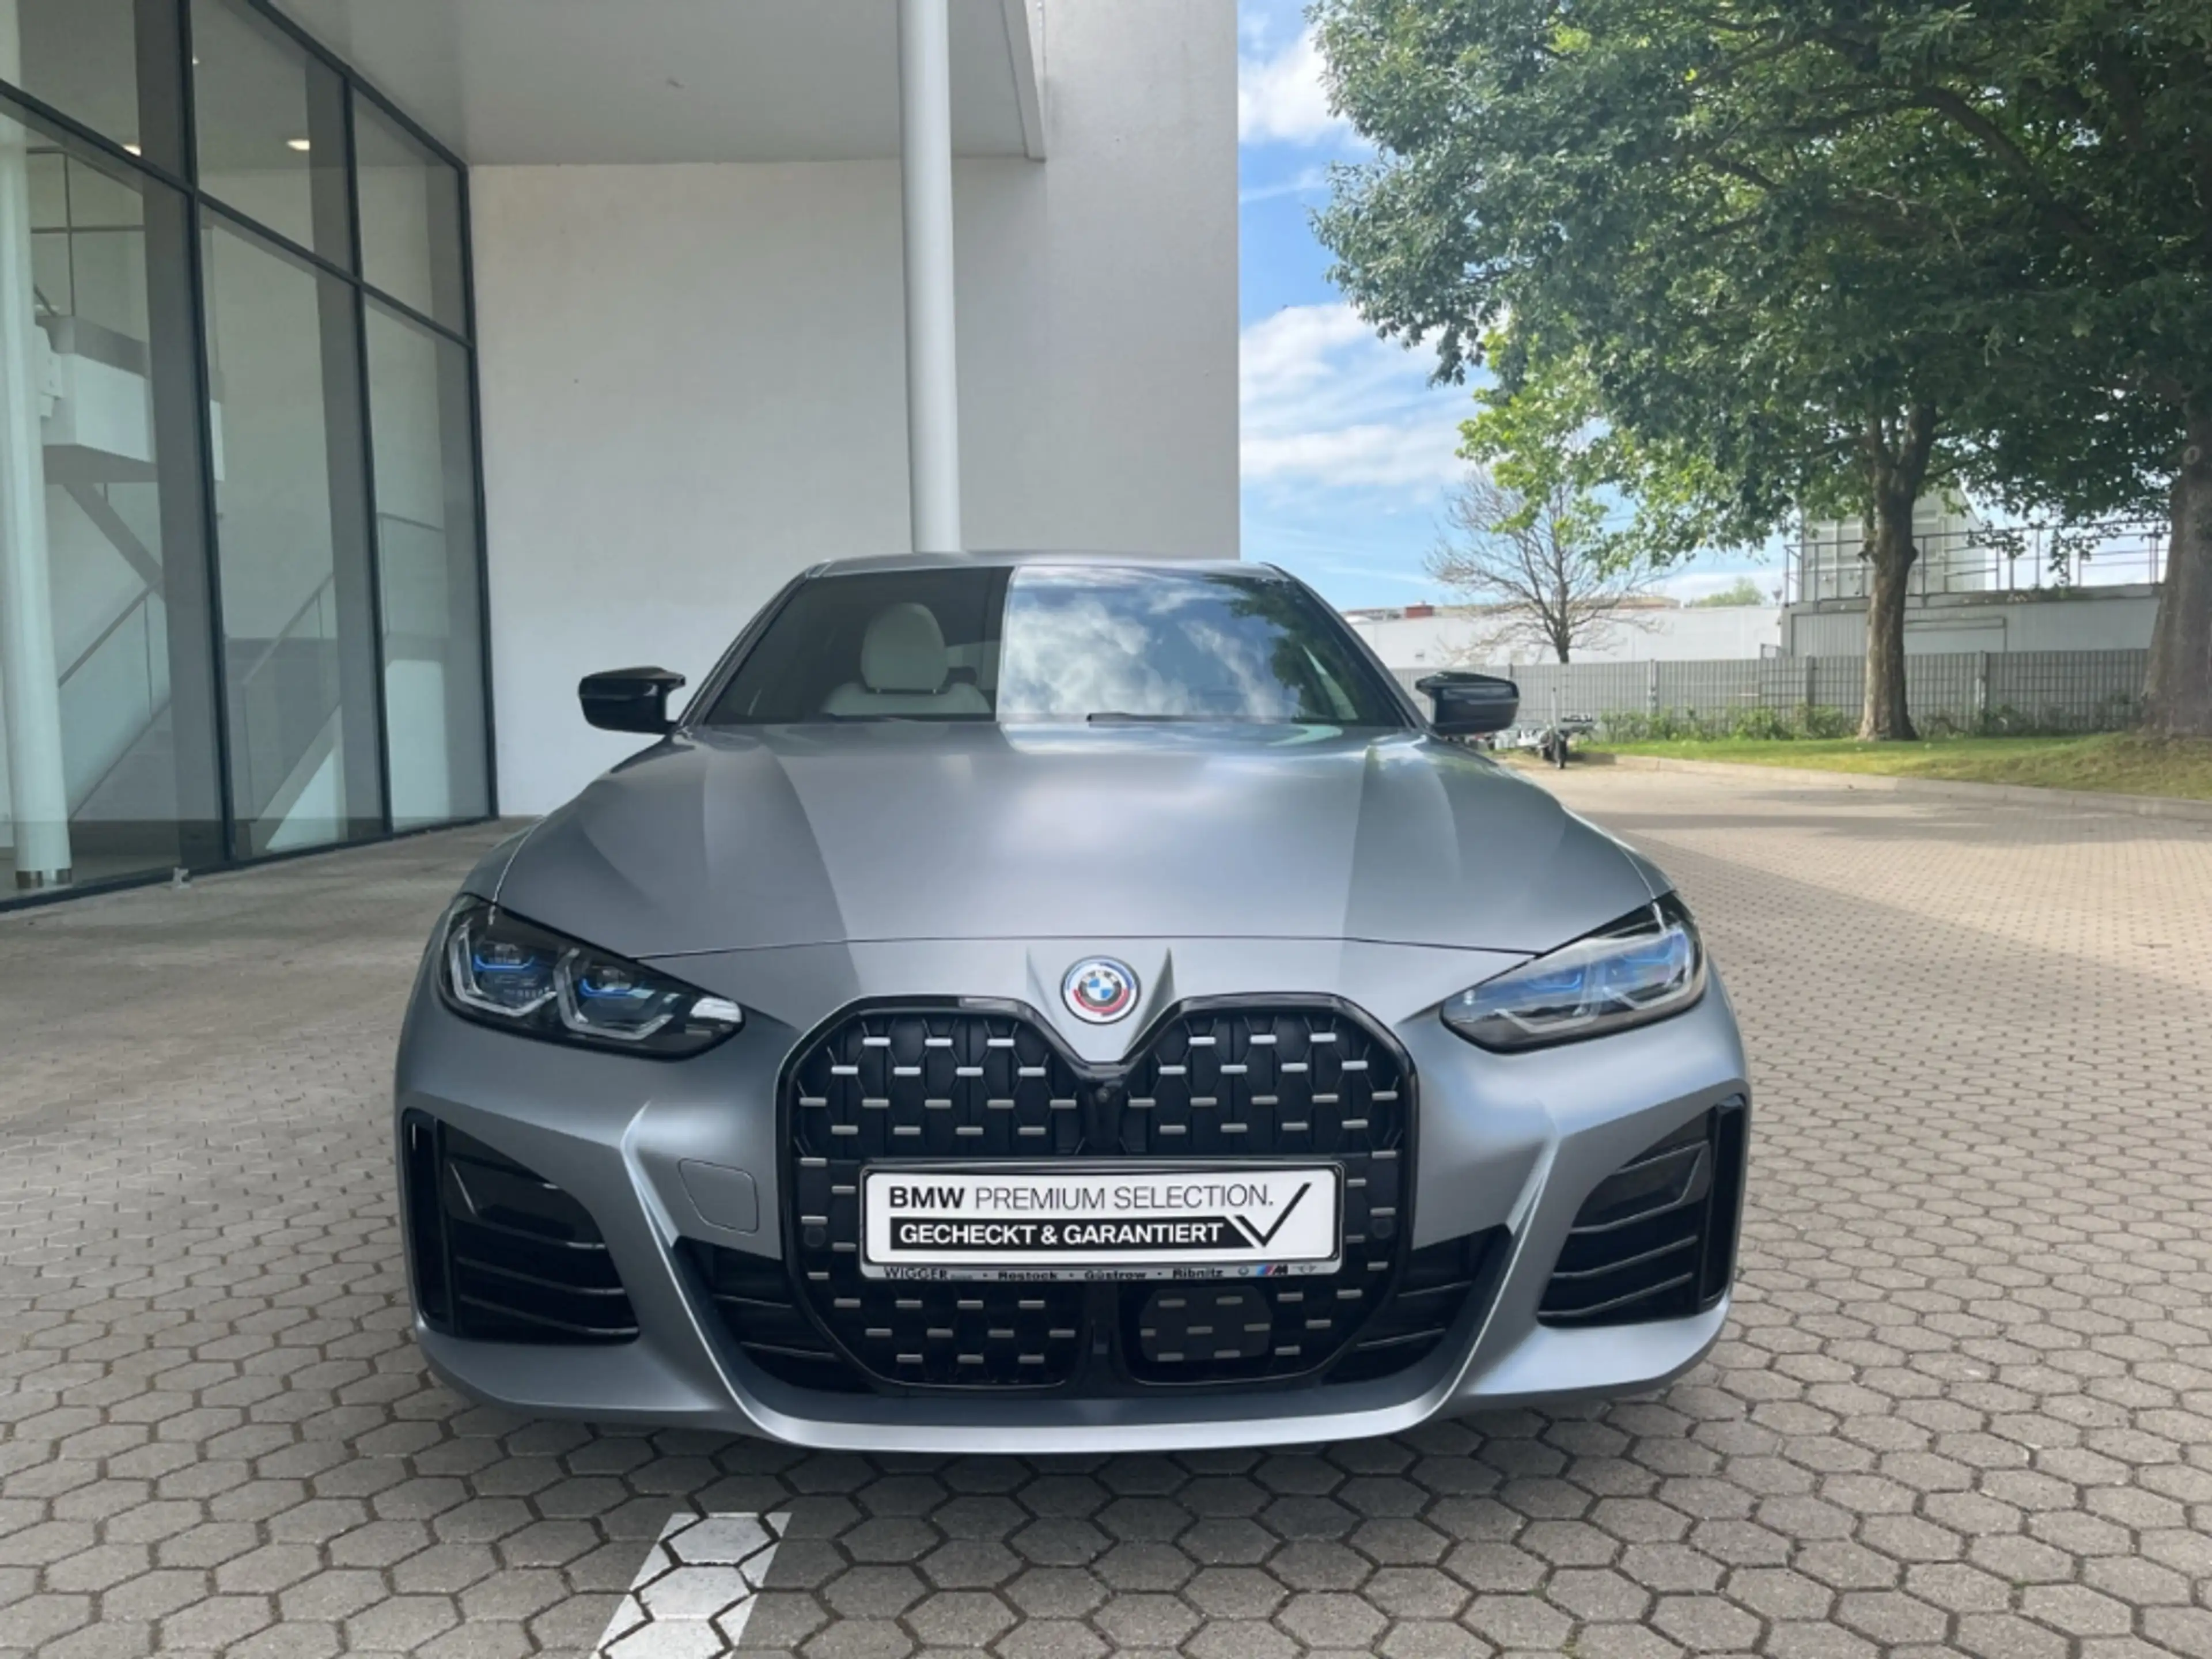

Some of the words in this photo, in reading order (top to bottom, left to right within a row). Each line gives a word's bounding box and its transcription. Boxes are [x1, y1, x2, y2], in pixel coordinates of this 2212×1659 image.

[889, 1186, 964, 1209] BMW
[975, 1187, 1105, 1210] PREMIUM
[1113, 1183, 1274, 1209] SELECTION.
[899, 1223, 1037, 1245] GECHECKT
[1040, 1224, 1058, 1244] &
[1063, 1222, 1224, 1244] GARANTIERT
[884, 1267, 948, 1279] WIGGER
